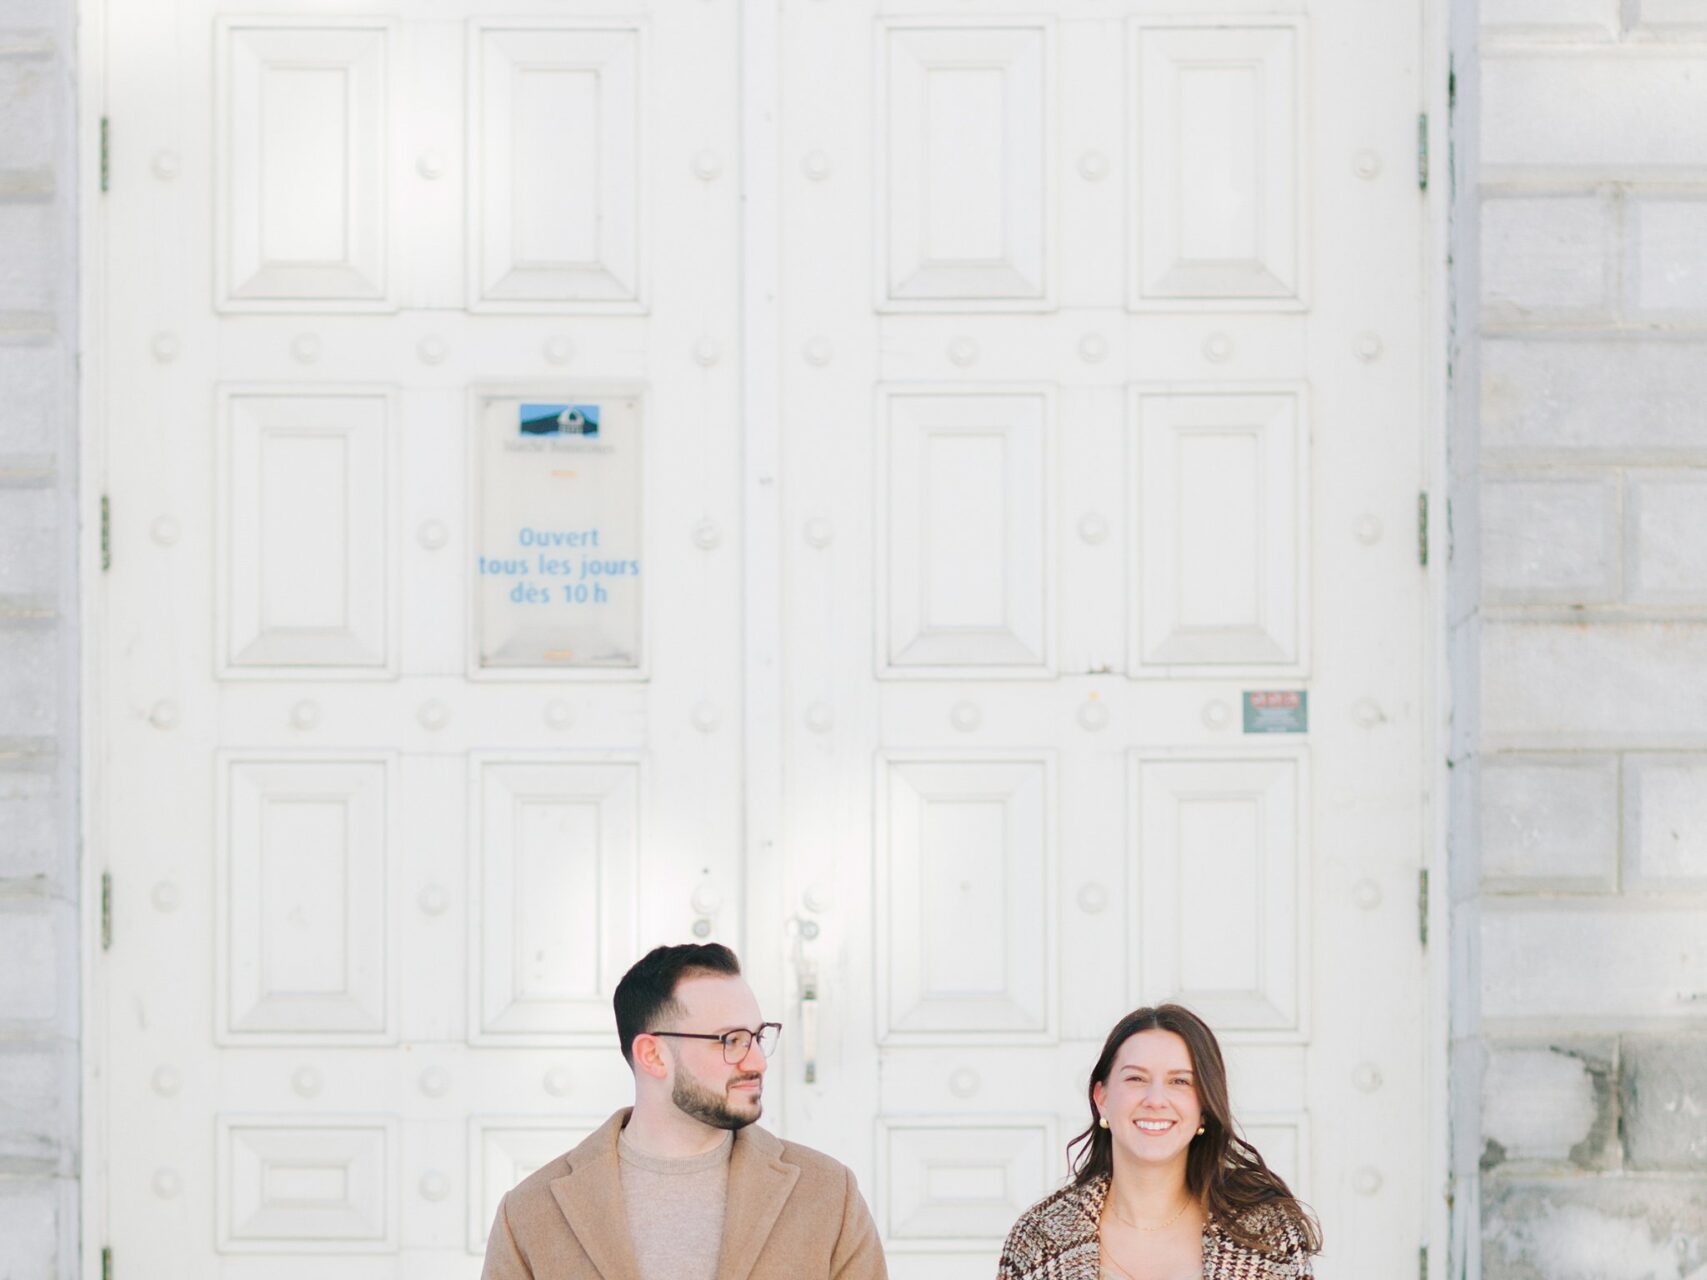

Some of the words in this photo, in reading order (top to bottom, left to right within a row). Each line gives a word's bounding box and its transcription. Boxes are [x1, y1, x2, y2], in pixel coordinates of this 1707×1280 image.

[519, 528, 600, 547] Ouvert
[479, 556, 528, 576] tous
[539, 556, 572, 576] les
[579, 557, 640, 580] jours
[510, 582, 551, 604] dès
